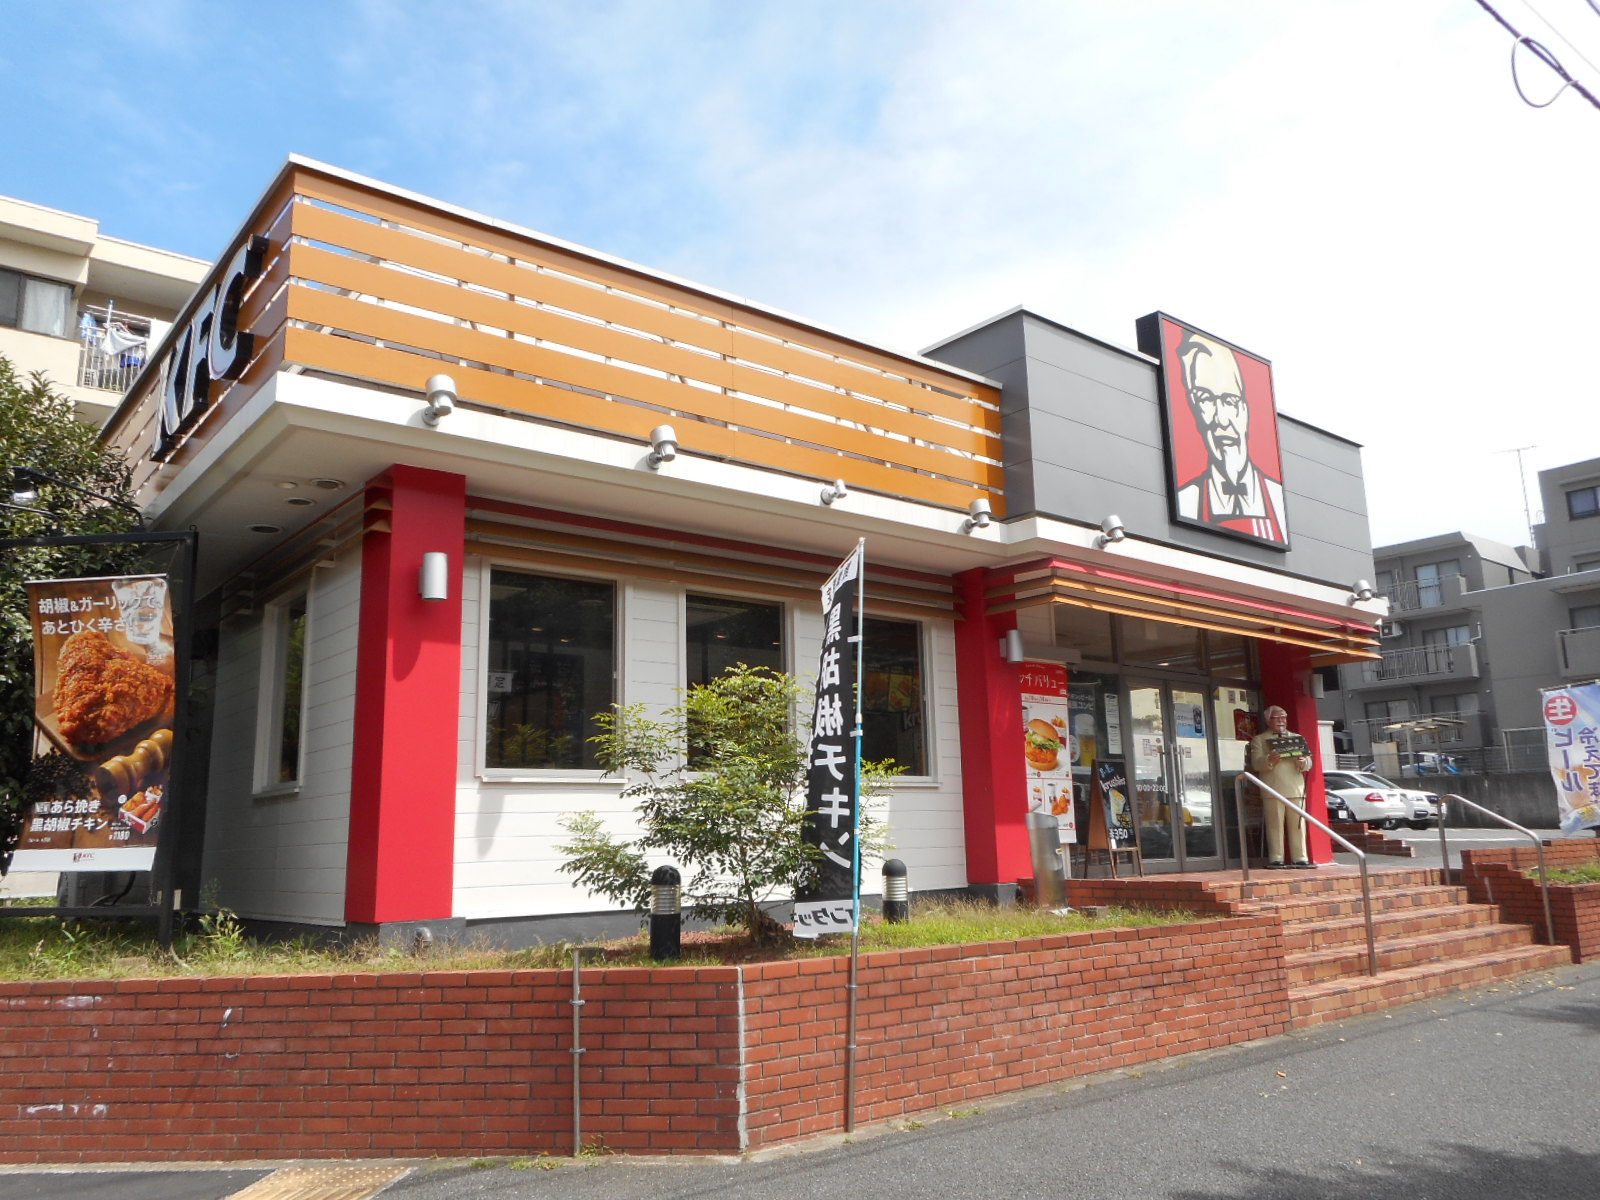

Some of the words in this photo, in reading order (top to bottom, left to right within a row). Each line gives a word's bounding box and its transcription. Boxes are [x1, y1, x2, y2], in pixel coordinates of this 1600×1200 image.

[149, 233, 269, 462] KFC
[50, 799, 102, 814] あら挽き
[29, 817, 109, 832] 黒胡椒チキン
